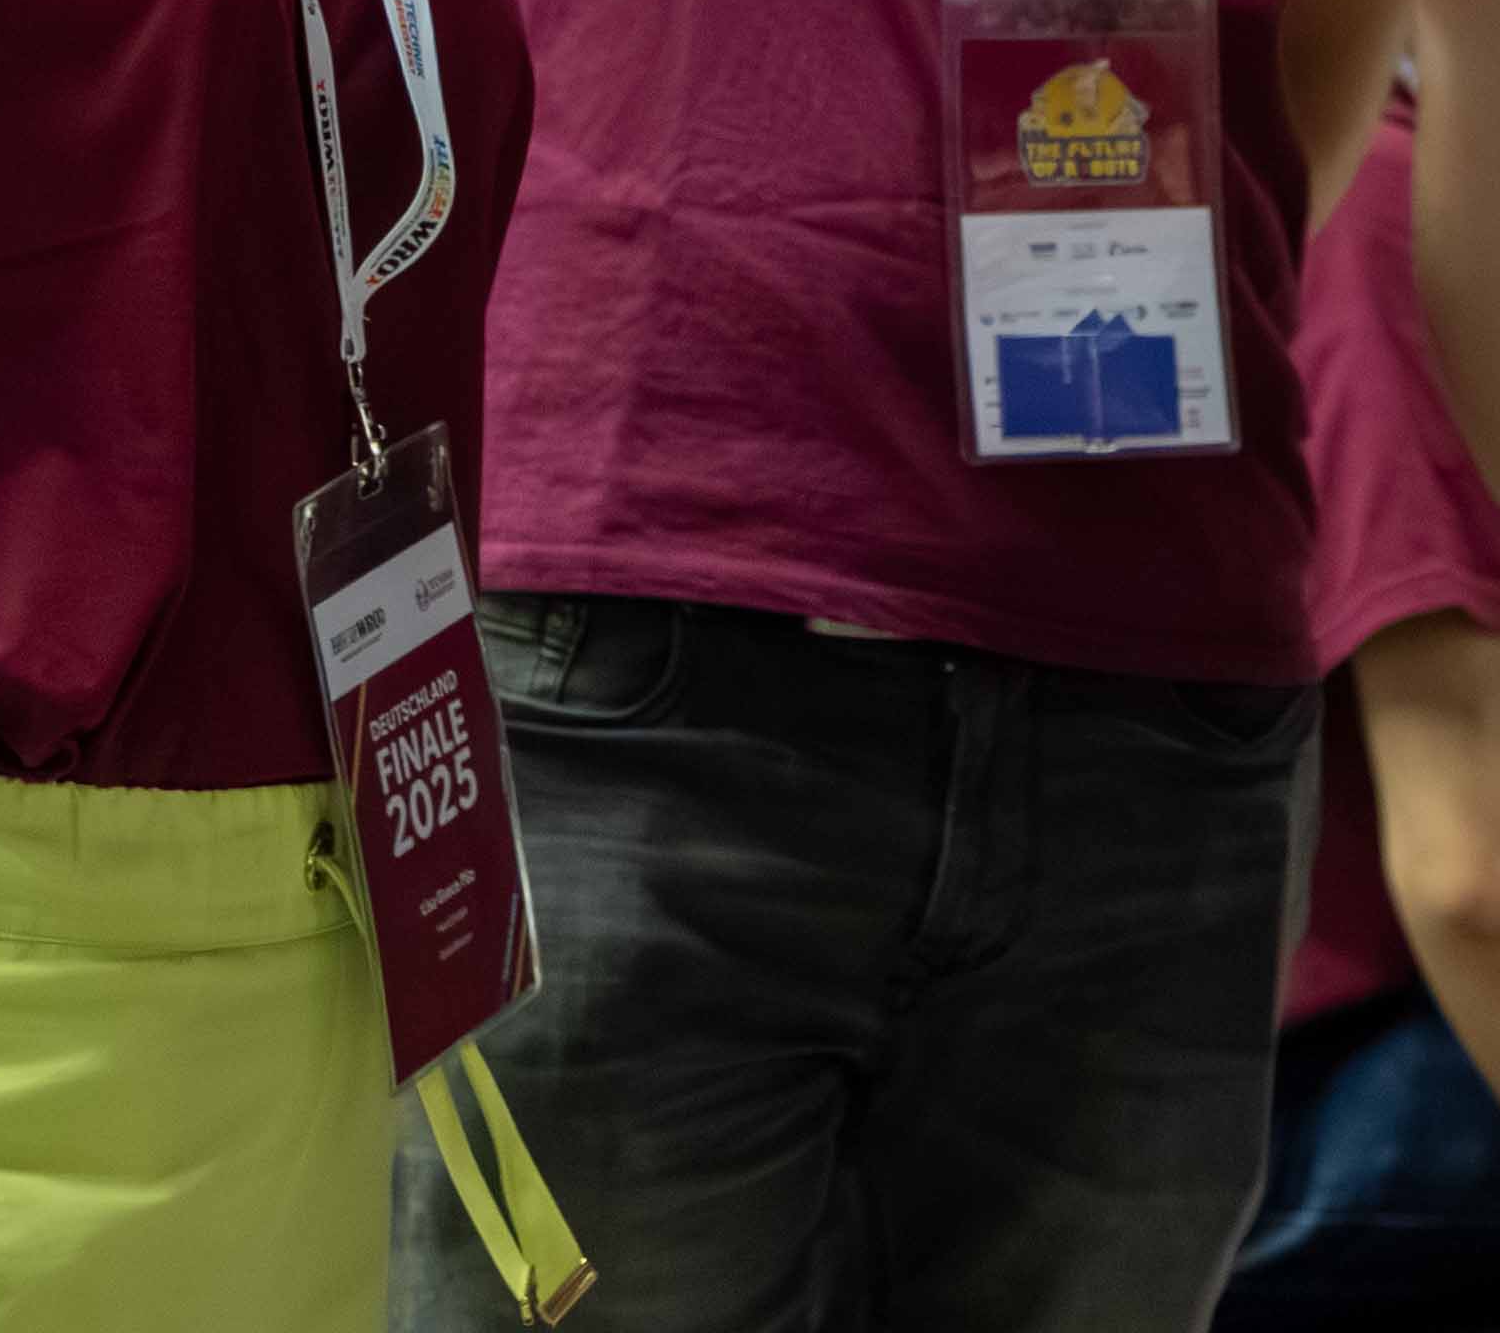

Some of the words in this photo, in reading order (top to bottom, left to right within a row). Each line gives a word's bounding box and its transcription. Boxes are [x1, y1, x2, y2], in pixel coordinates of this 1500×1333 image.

[376, 219, 439, 277] WRO
[369, 668, 459, 742] DEUTSCHLAND
[375, 697, 469, 796] FINALE
[385, 745, 480, 859] 2025
